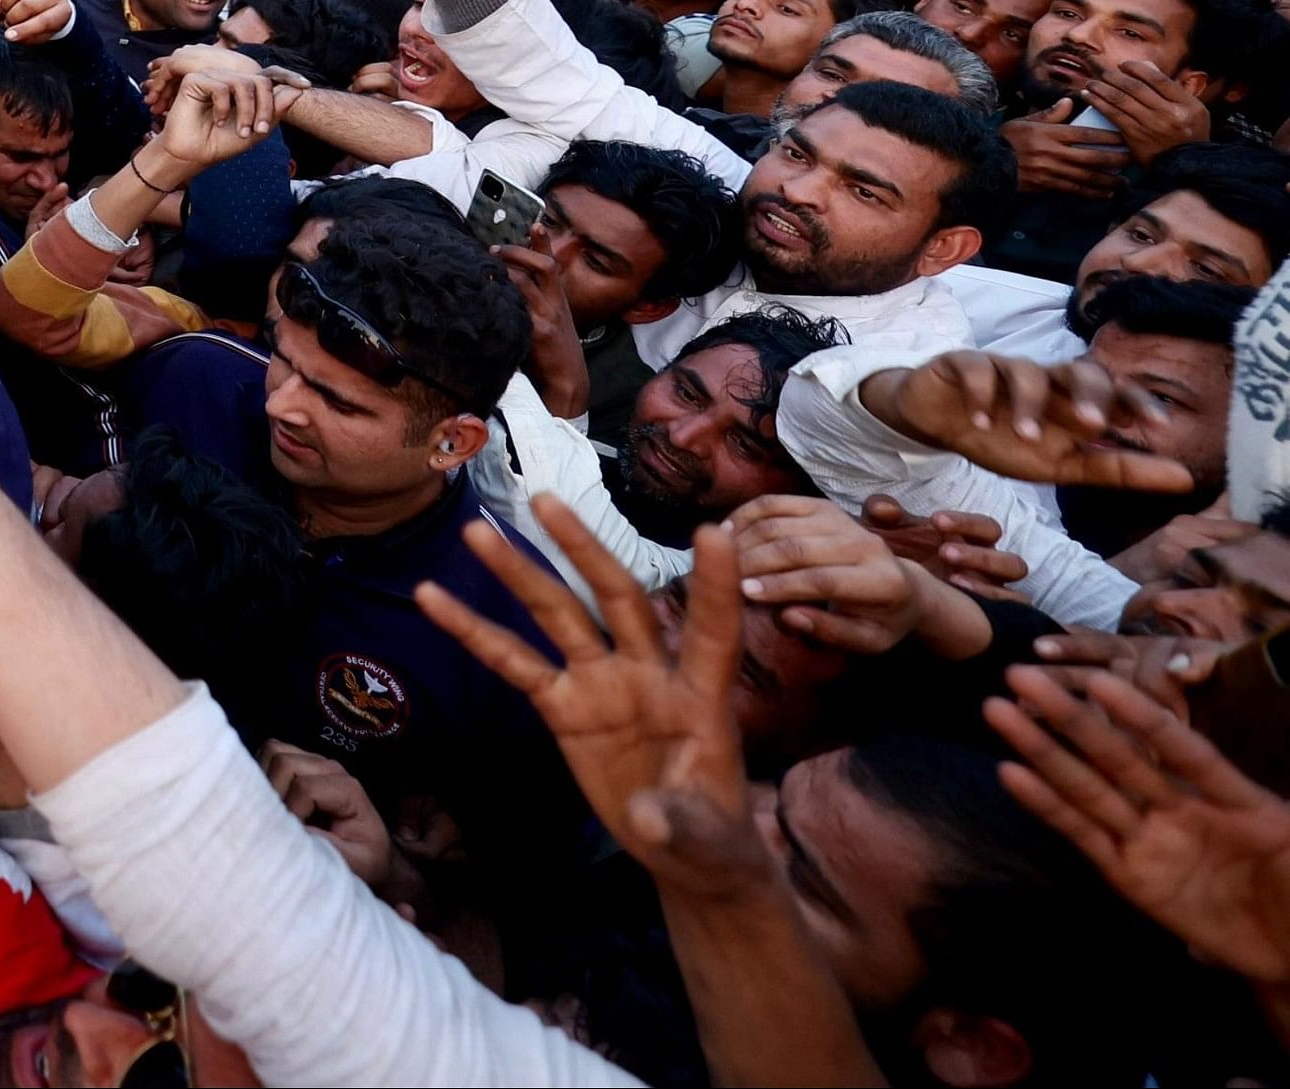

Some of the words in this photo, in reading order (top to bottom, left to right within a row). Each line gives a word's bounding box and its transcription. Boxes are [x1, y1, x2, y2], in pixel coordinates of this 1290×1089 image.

[346, 655, 391, 680] SECURITY
[388, 679, 405, 702] WING
[319, 726, 359, 752] 235
